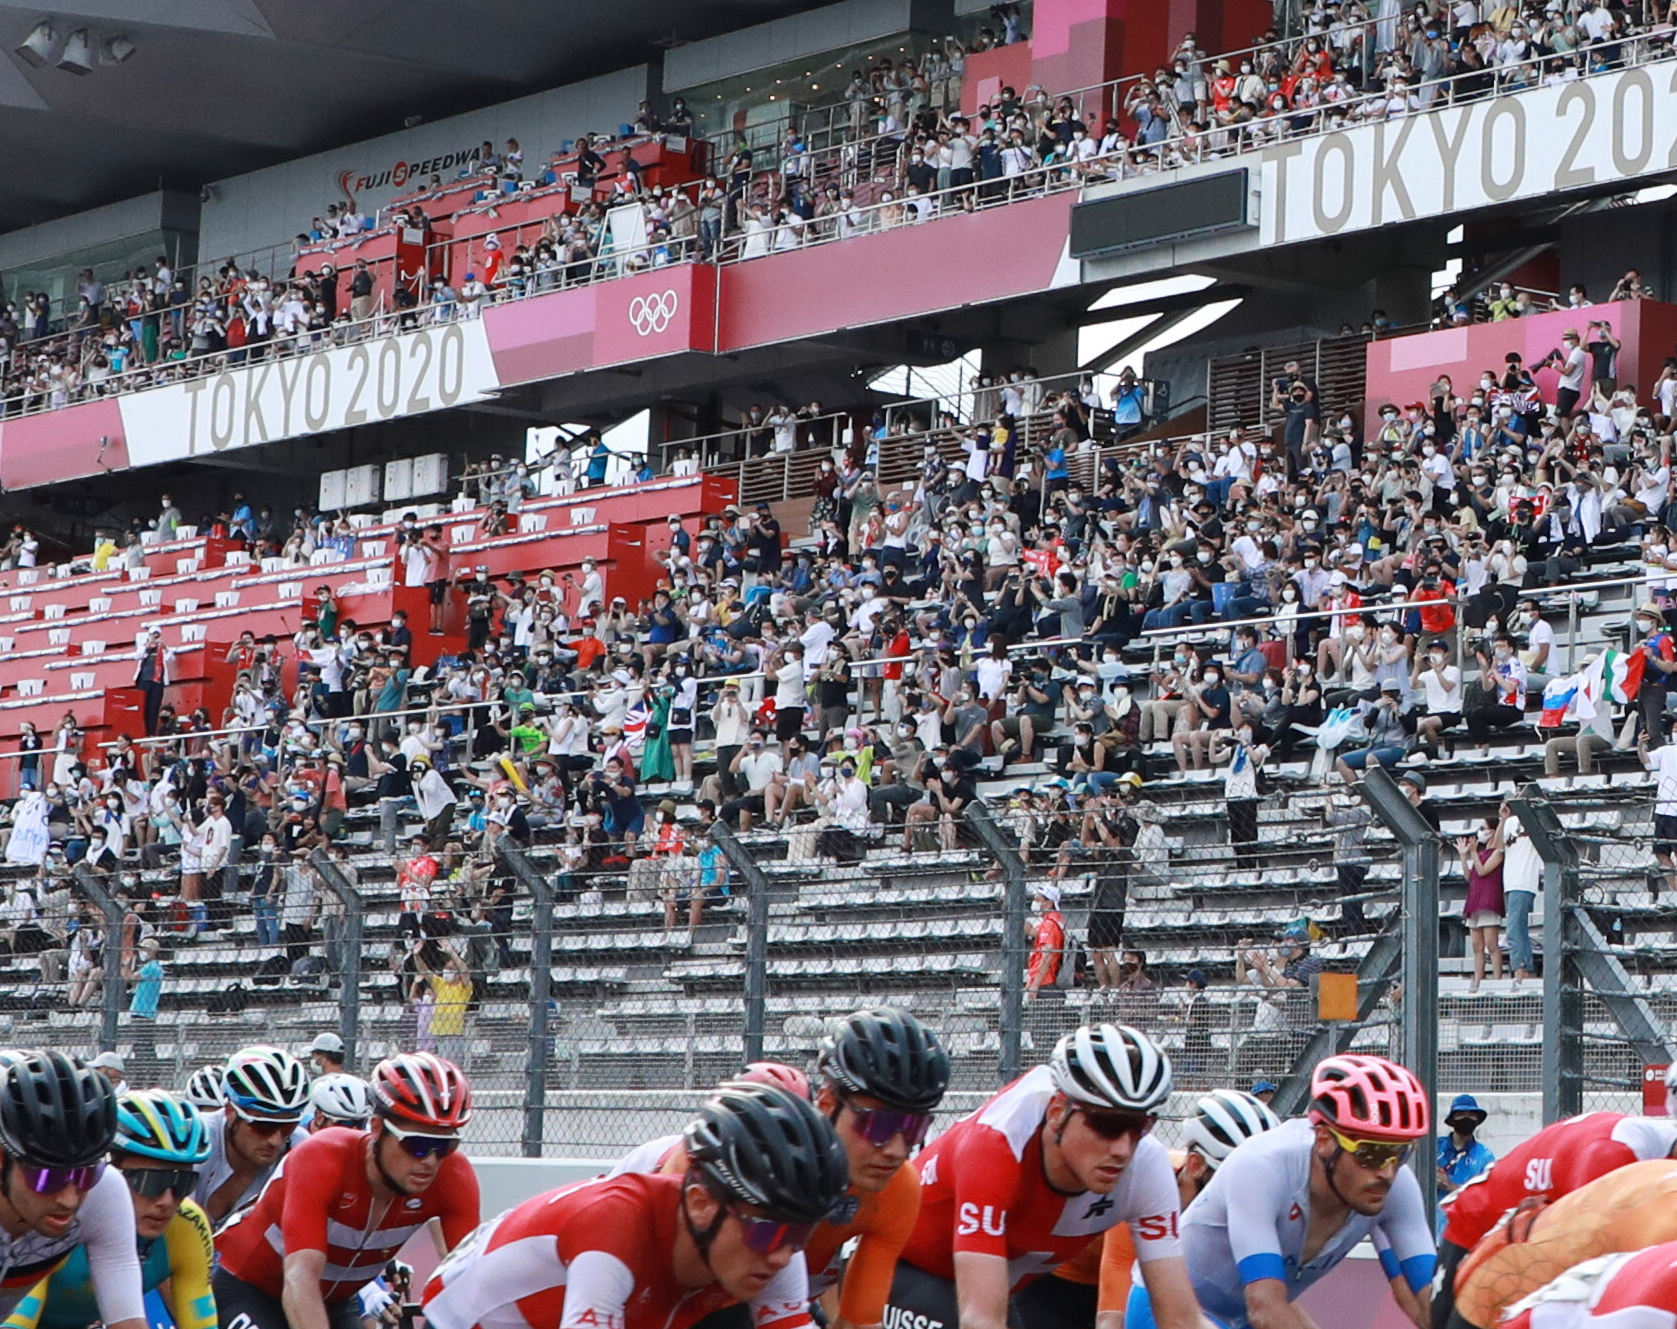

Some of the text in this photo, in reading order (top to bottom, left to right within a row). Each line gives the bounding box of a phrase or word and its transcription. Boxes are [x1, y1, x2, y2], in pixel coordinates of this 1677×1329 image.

[392, 149, 481, 187] SPEEDWA
[1261, 96, 1525, 244] TOKYO
[183, 324, 465, 456] TOKYO 2020
